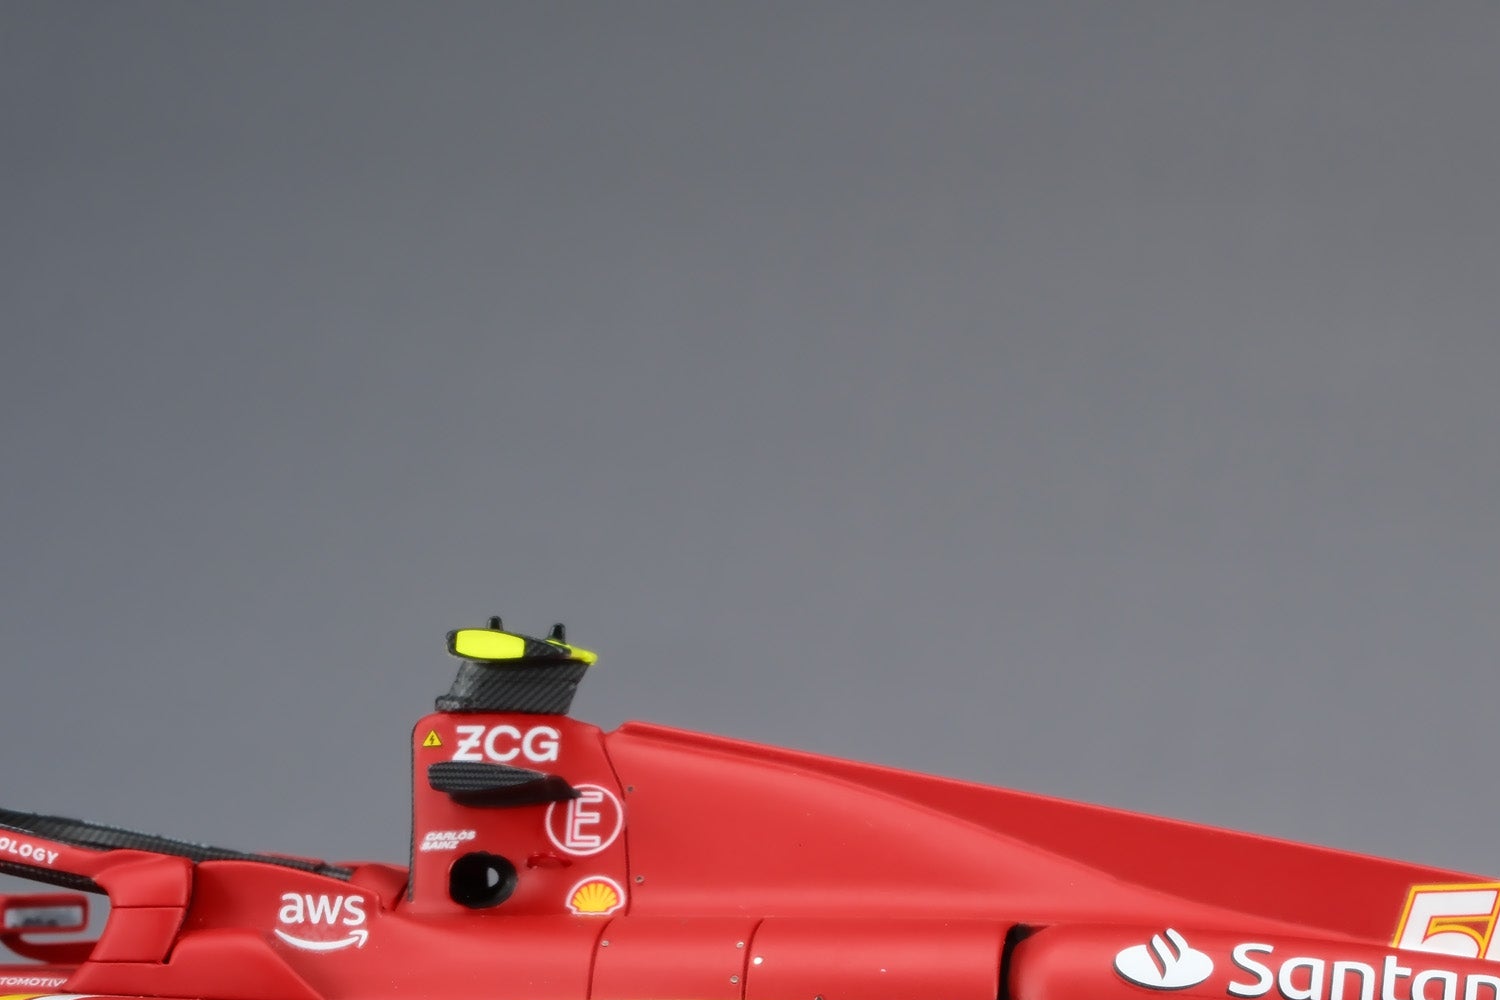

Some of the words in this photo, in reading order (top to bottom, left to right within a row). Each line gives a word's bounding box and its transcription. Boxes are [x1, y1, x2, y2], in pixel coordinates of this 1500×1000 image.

[425, 830, 476, 841] CARLOS
[0, 837, 59, 865] OLOGY
[420, 840, 460, 851] SAINZ
[279, 893, 366, 926] aws
[0, 976, 68, 988] TOMOTIV
